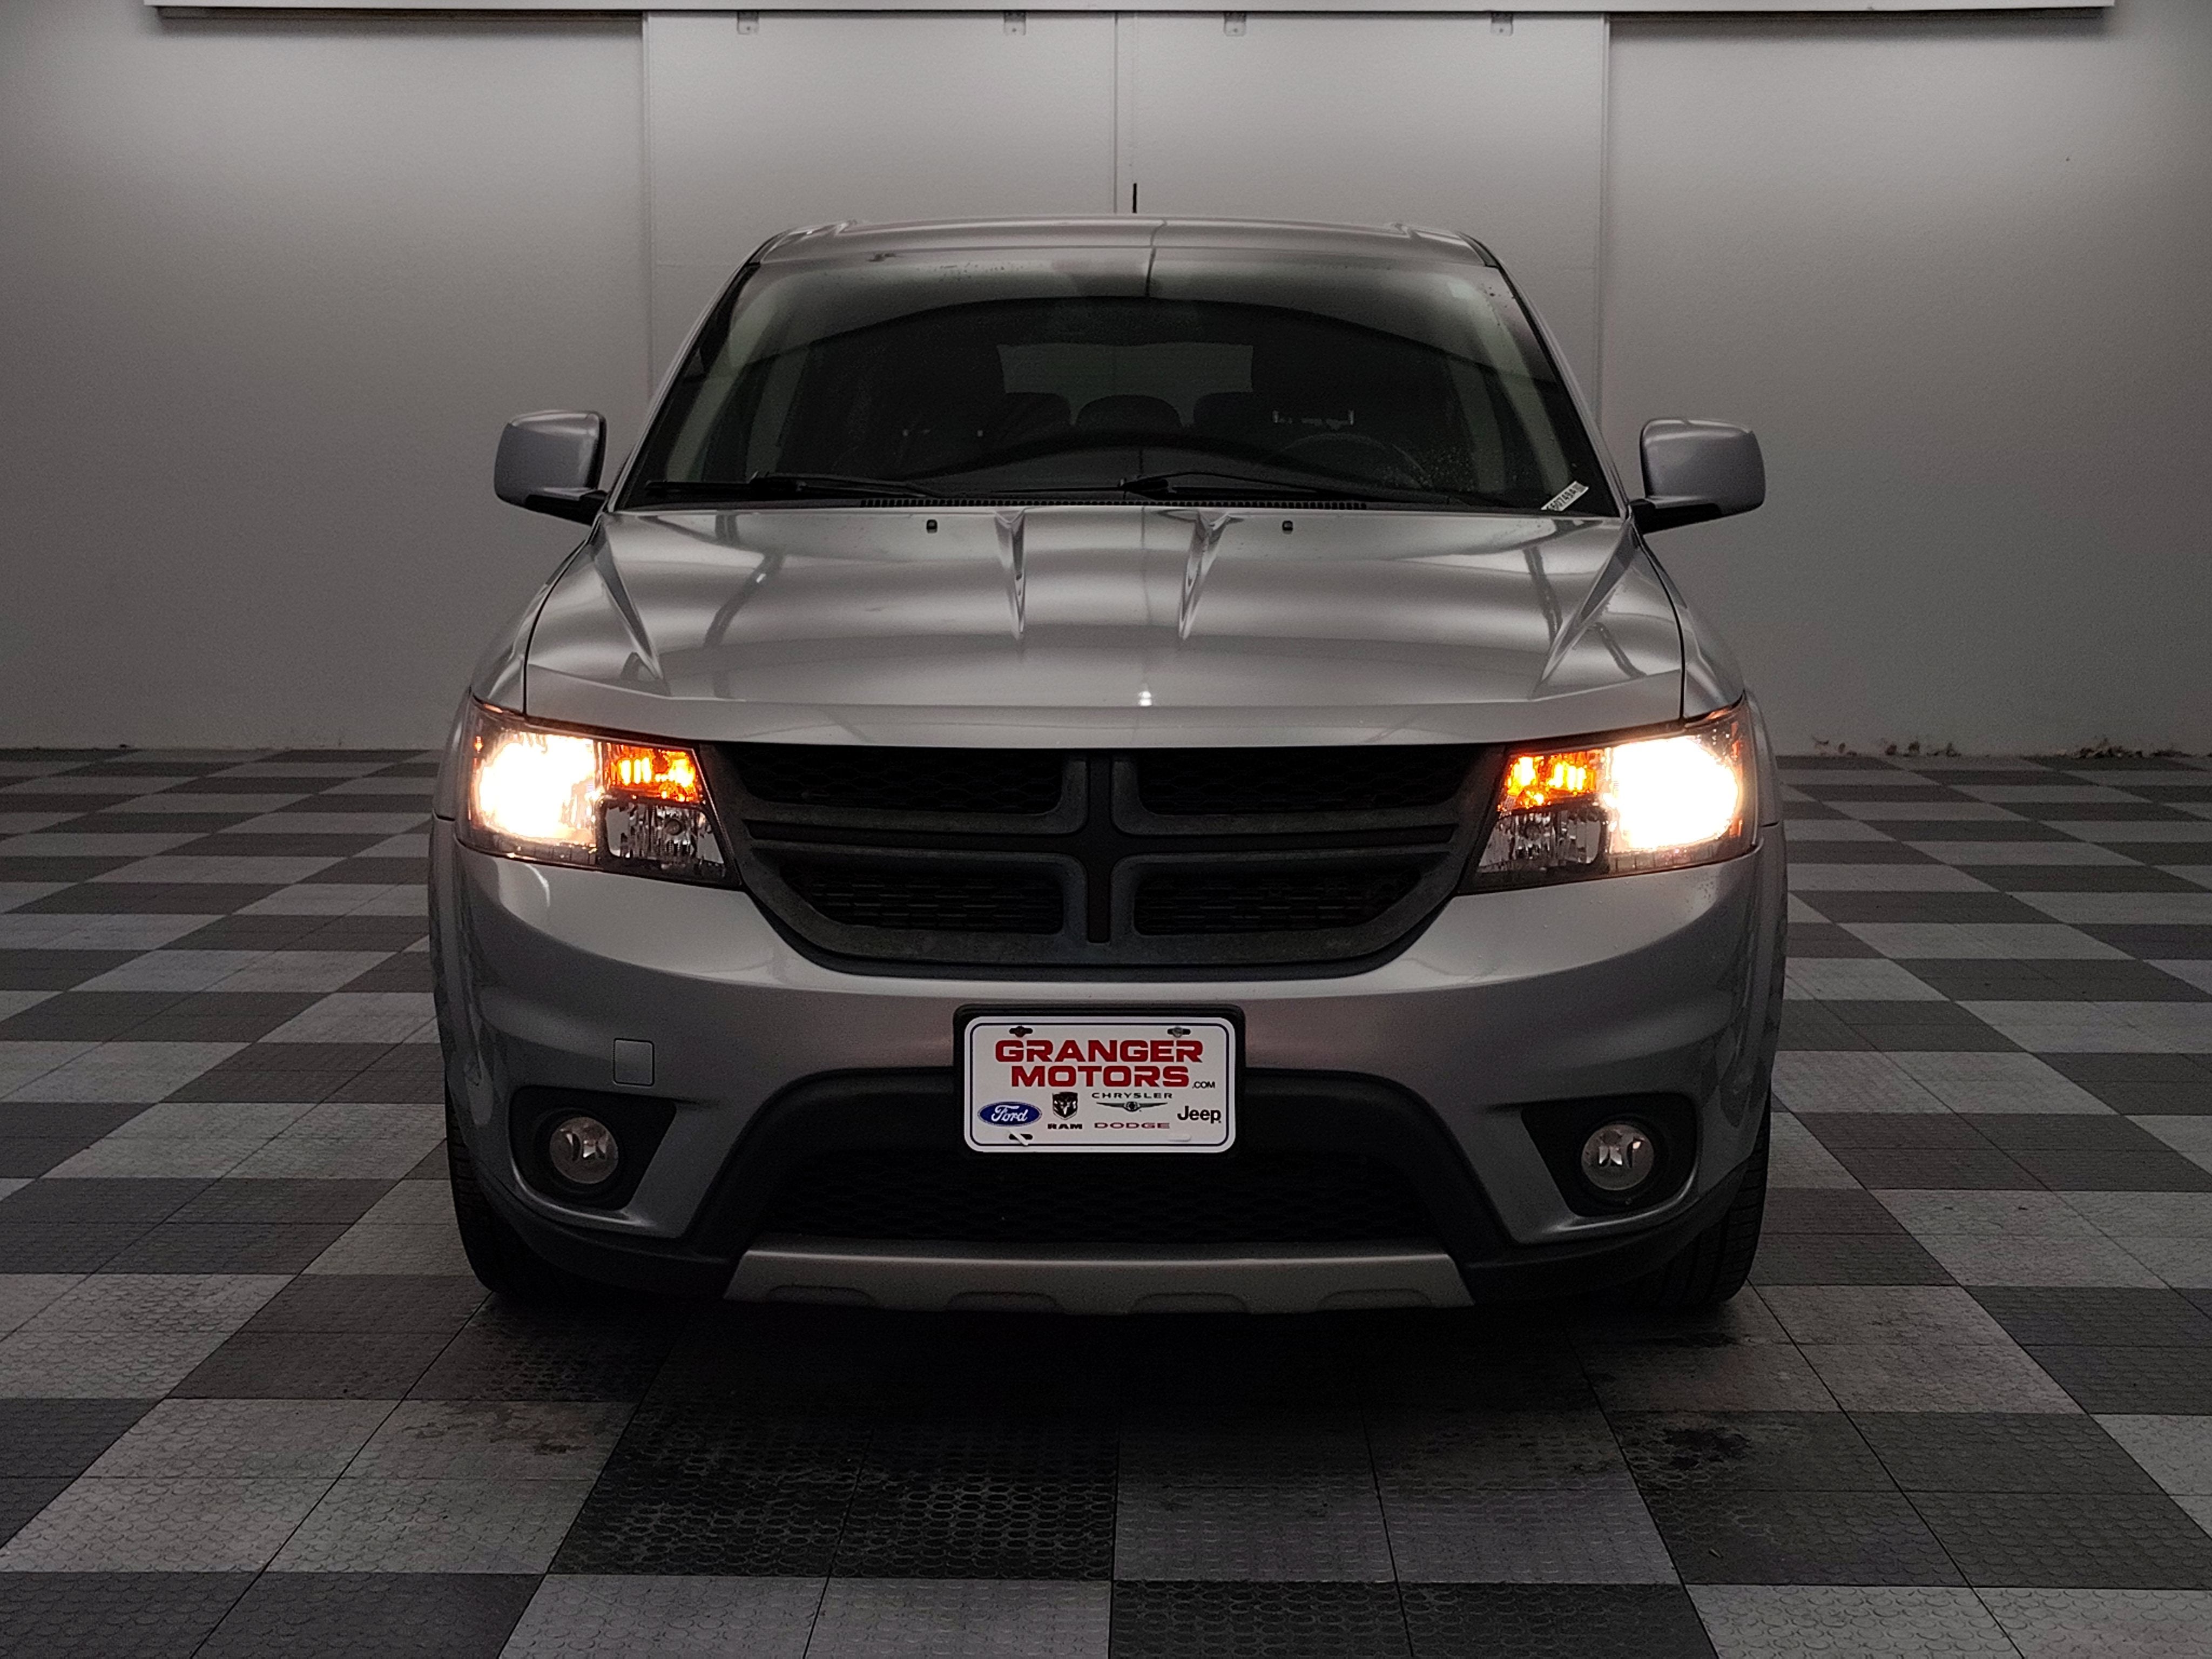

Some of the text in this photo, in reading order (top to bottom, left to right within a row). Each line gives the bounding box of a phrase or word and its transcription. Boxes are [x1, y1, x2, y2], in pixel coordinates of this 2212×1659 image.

[995, 1040, 1203, 1063] GRANGER
[1011, 1065, 1190, 1087] MOTORS
[991, 1104, 1029, 1122] Ford
[1177, 1105, 1222, 1124] Jeep
